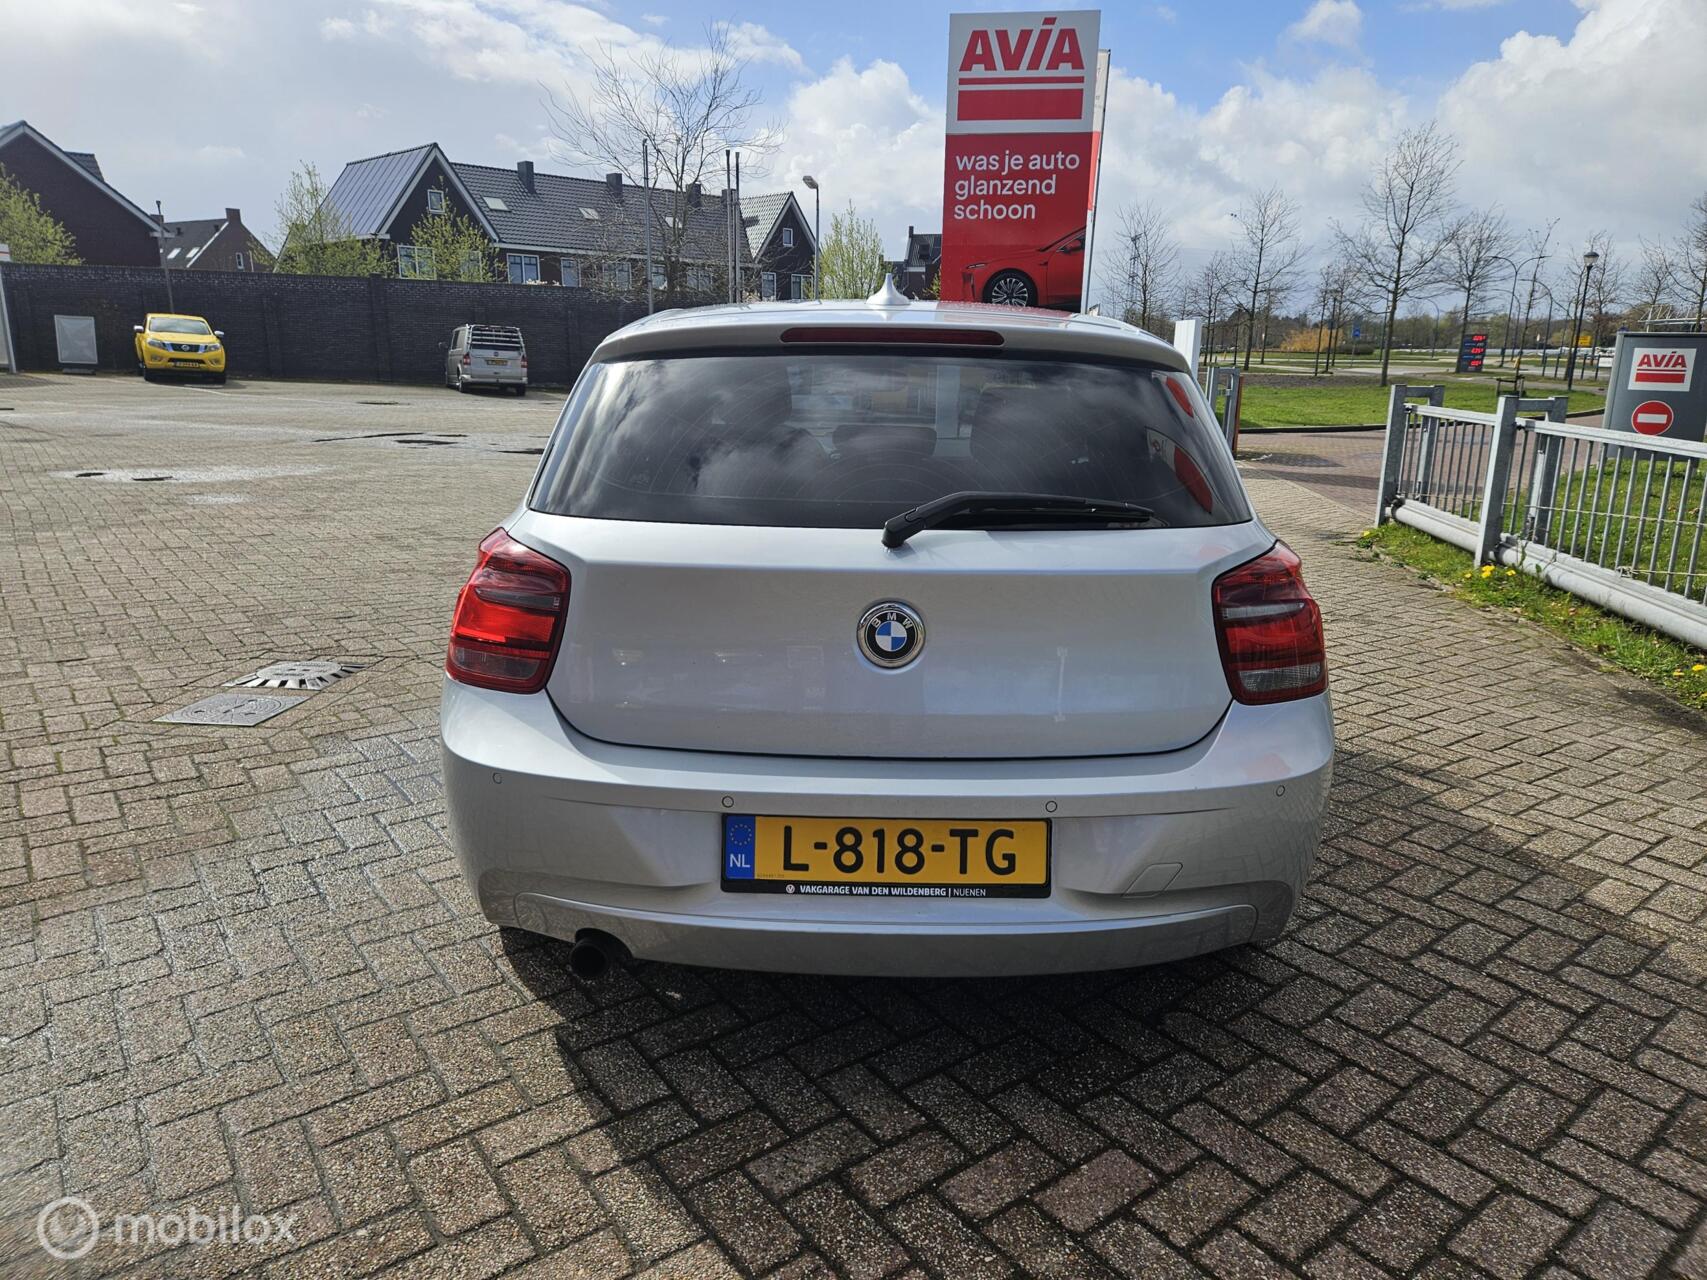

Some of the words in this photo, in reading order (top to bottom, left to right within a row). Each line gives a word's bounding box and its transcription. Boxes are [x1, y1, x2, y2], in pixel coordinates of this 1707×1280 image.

[956, 154, 1000, 171] was
[1001, 150, 1024, 176] je
[1028, 151, 1080, 170] auto
[955, 174, 1057, 201] glanzend
[954, 199, 1036, 220] schoon
[870, 612, 913, 630] BMW
[729, 853, 751, 868] NL
[783, 825, 1017, 876] L-818-TG
[800, 884, 850, 895] VAKGARAGE
[851, 886, 870, 896] VAN
[871, 886, 889, 896] DEN
[890, 887, 946, 897] WILDENBERG
[953, 888, 987, 897] NUENEN
